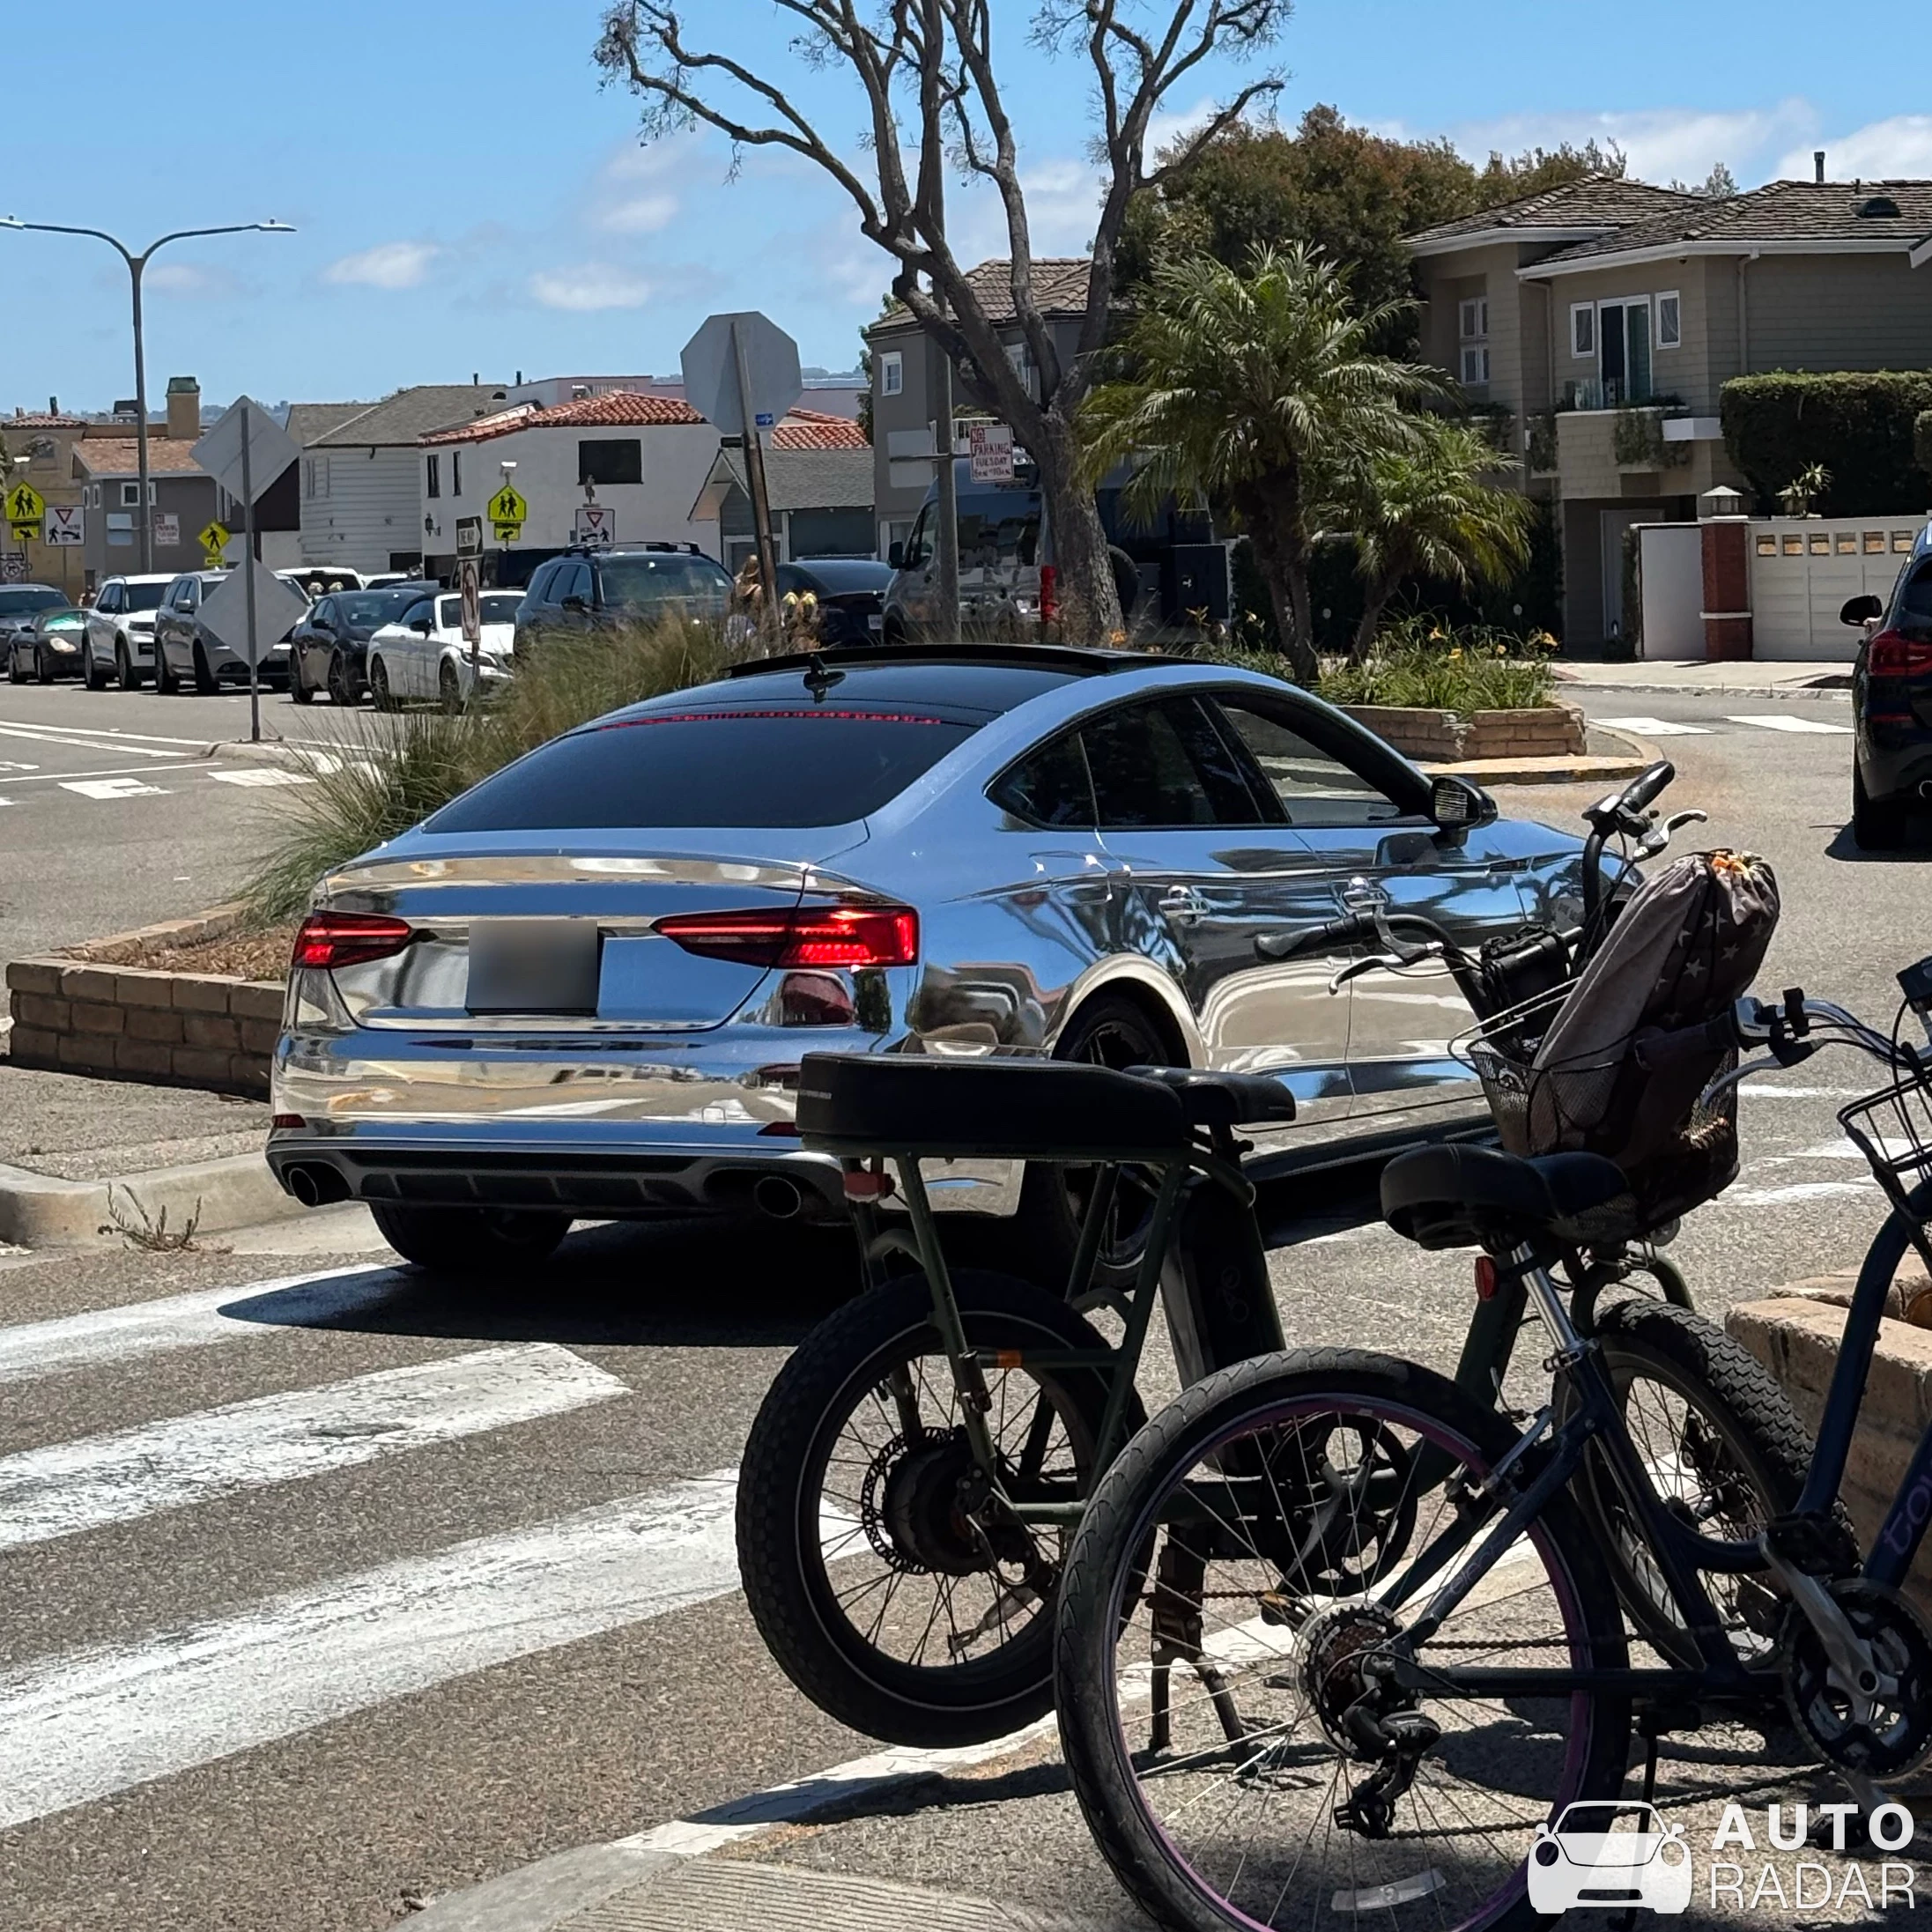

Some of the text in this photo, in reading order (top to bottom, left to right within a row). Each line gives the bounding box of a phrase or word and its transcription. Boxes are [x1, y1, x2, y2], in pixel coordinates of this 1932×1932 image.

[972, 429, 984, 442] NO
[973, 443, 1010, 456] PARKING
[975, 456, 1007, 467] TUESDAY
